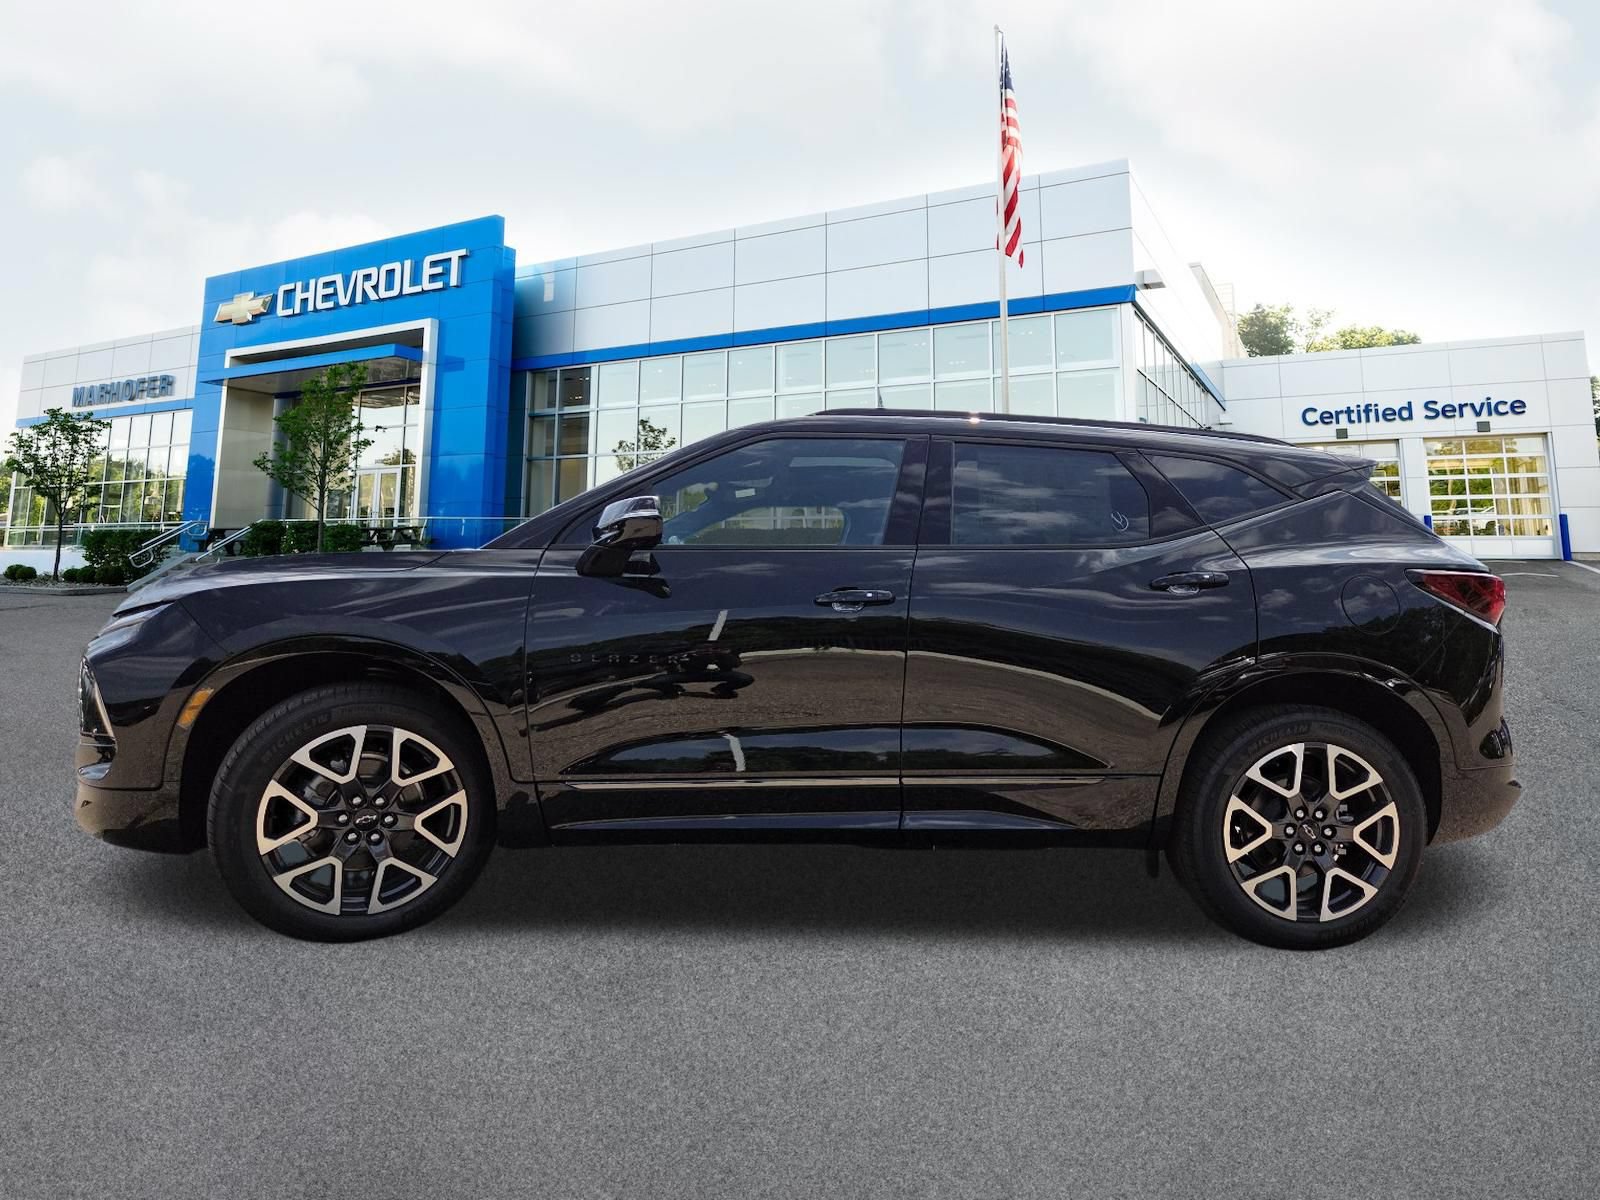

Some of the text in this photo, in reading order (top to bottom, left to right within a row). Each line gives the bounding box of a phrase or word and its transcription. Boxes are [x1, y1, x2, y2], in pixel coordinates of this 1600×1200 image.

[276, 248, 469, 317] CHEVROLET
[72, 375, 175, 407] MARHOFER
[1301, 397, 1527, 427] Certified Service
